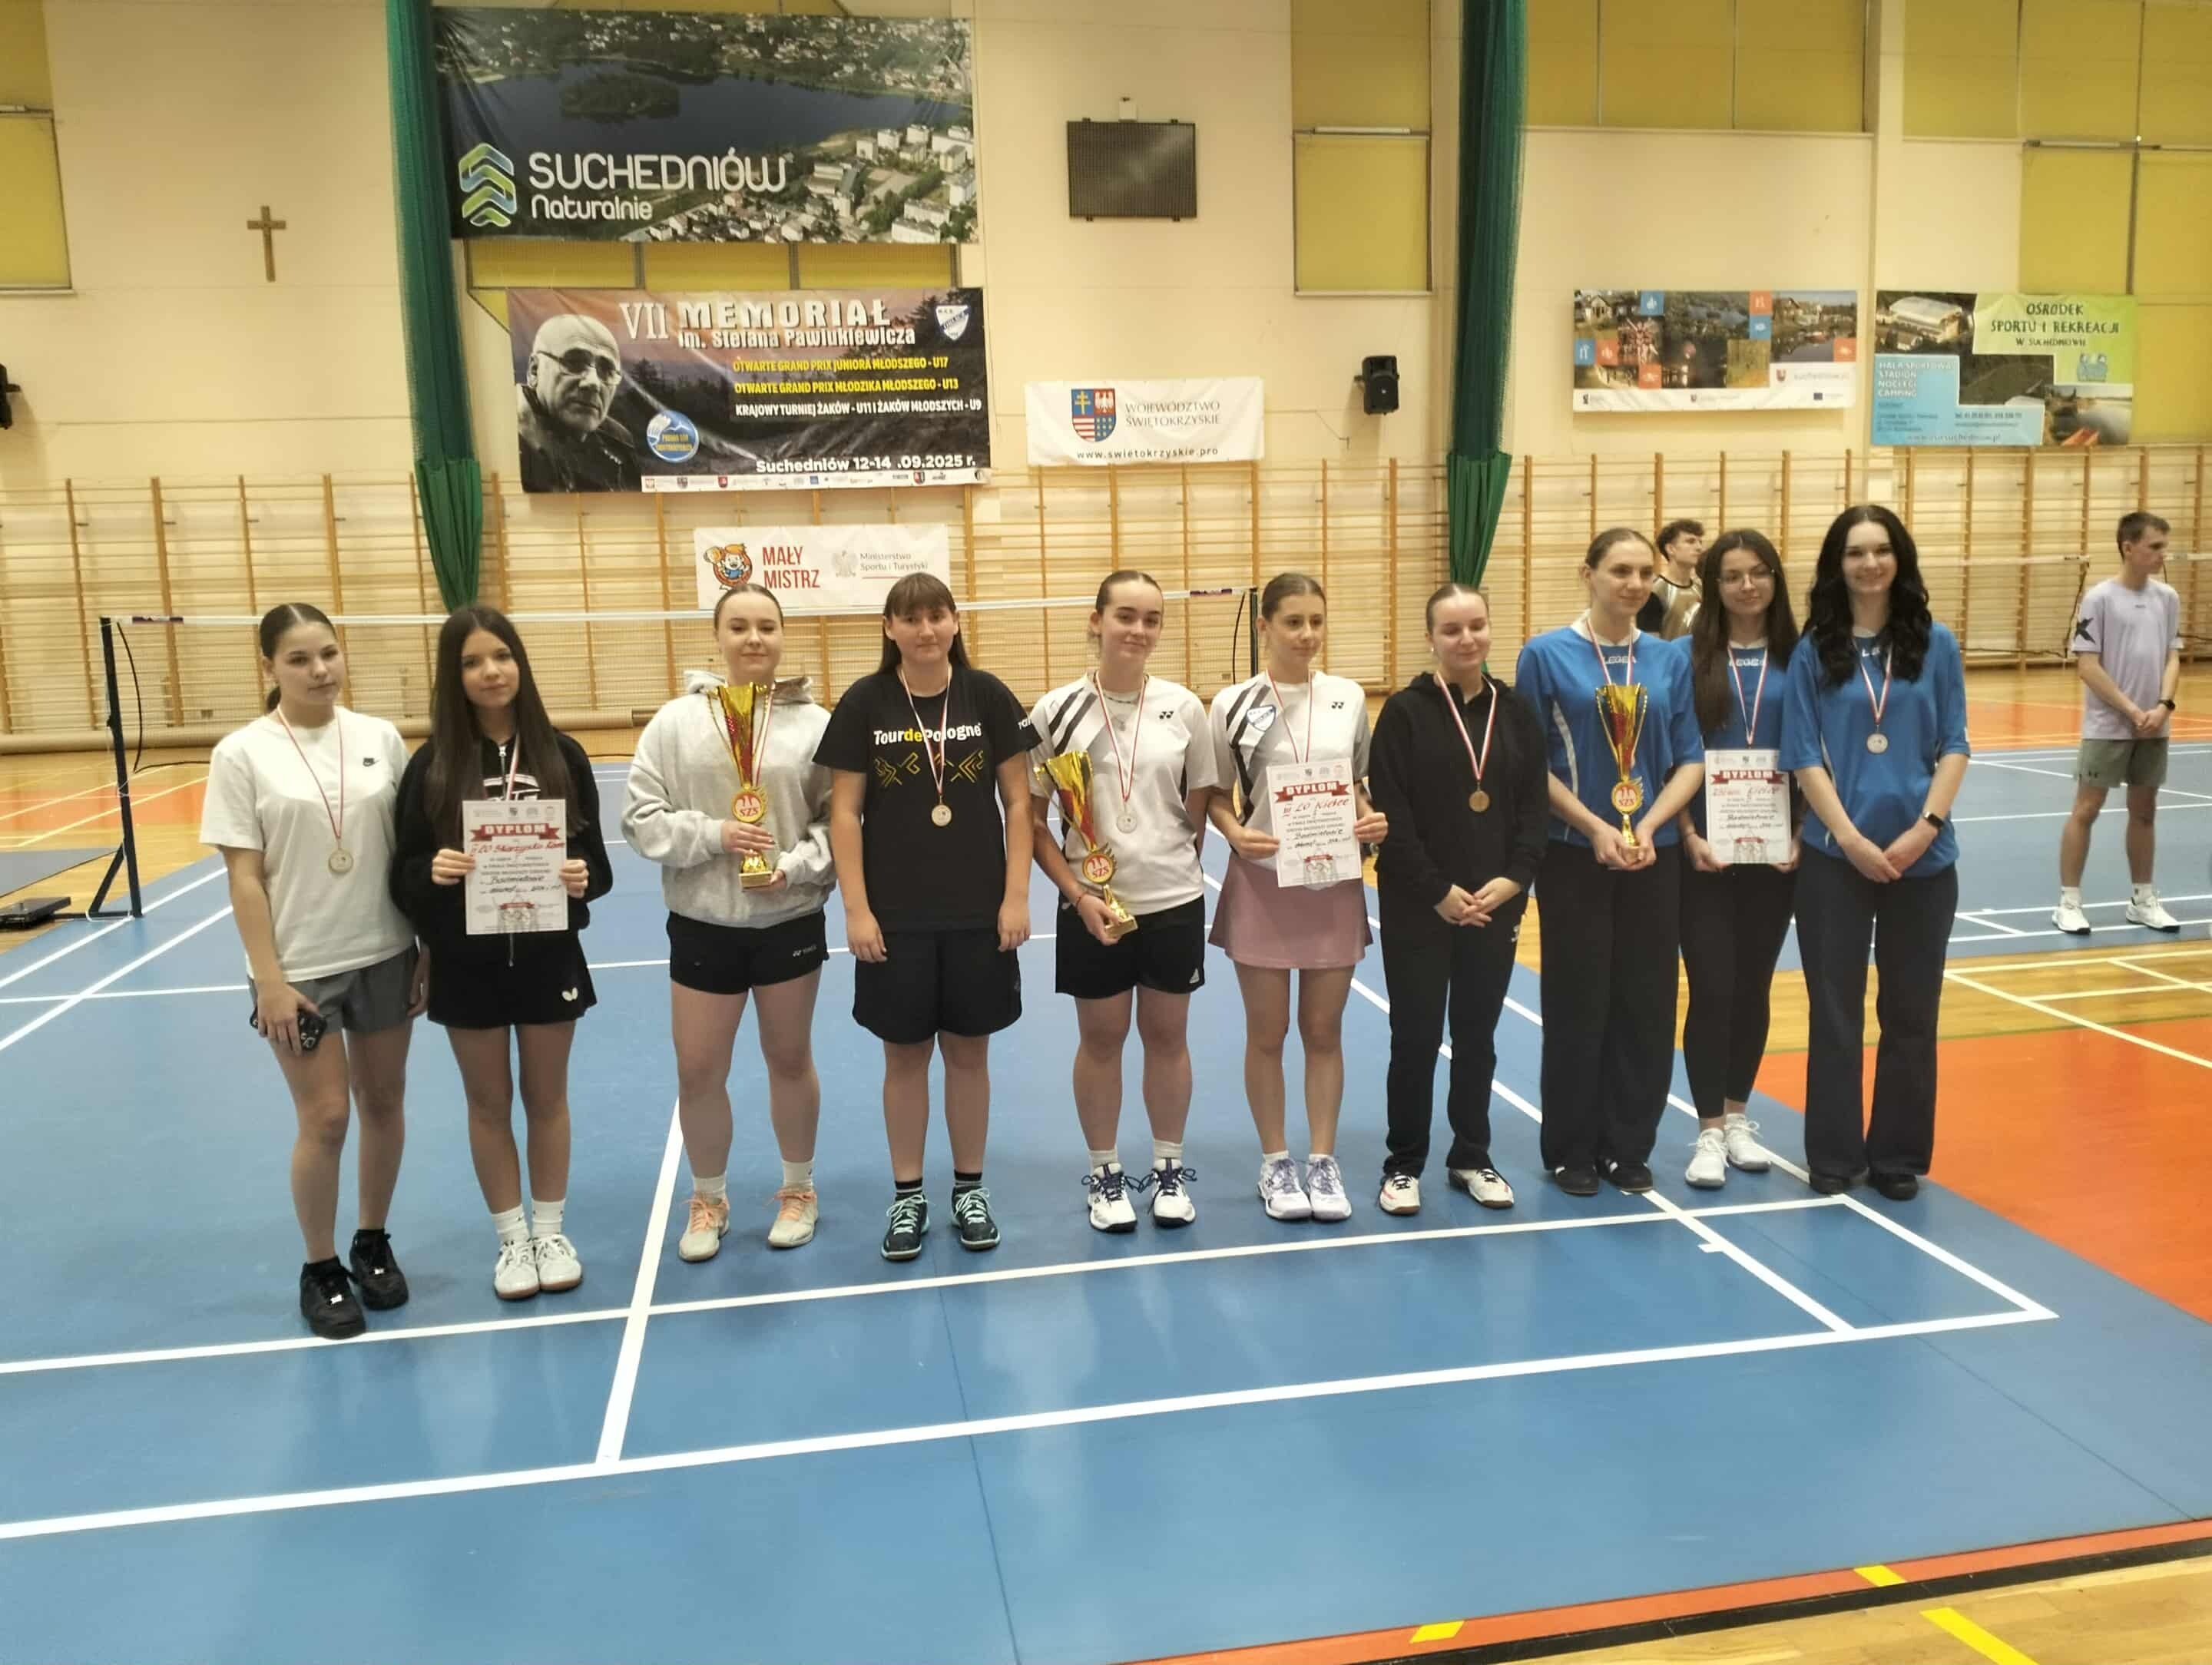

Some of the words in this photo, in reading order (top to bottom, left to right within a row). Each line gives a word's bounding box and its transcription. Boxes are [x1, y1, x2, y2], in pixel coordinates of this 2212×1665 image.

[528, 147, 786, 192] SUCHEDNIÓW
[531, 194, 653, 220] Naturalnie
[2026, 302, 2084, 315] OŚRODEK
[619, 302, 669, 339] VII
[677, 299, 891, 329] MEMORIAŁ
[1991, 319, 2036, 332] SPORTU
[2054, 320, 2119, 333] REKREACJI
[712, 329, 779, 348] Stefana
[733, 360, 777, 372] OTWARTE
[778, 359, 810, 371] GRAND
[811, 359, 833, 370] PRIX
[834, 358, 872, 372] JUNIORA
[873, 356, 927, 369] MŁODSZEGO
[933, 356, 949, 368] U17
[734, 382, 778, 393] OTWARTE
[779, 382, 811, 393] GRAND
[812, 381, 834, 392] PRIX
[836, 380, 882, 392] MŁODZIKA
[882, 379, 936, 391] MŁODSZEGO
[942, 378, 959, 389] U13
[735, 404, 779, 418] KRAJOWY
[779, 403, 816, 417] TURNIEJ
[817, 400, 850, 415] ŻAKÓW
[856, 402, 872, 414] U11
[877, 399, 910, 413] ŻAKÓW
[911, 399, 963, 412] MŁODSZYCH
[969, 399, 982, 411] U9
[1125, 400, 1220, 415] WOJEWÓDZTWO
[1126, 415, 1219, 428] ŚWIĘTOKRZYSKIE
[1077, 448, 1218, 458] www.swietokrzyskie.pro
[756, 457, 849, 473] Suchedniów
[853, 456, 892, 470] 12-14
[966, 455, 975, 466] r.
[762, 546, 803, 566] MAŁY
[860, 551, 912, 561] Ministerstwo
[860, 562, 887, 572] Sportu
[893, 561, 929, 571] Turystyki
[763, 570, 820, 589] MISTRZ
[1723, 770, 1773, 780] DYPLOM
[1286, 782, 1337, 796] DYPLOM
[485, 823, 547, 835] DYPLOM
